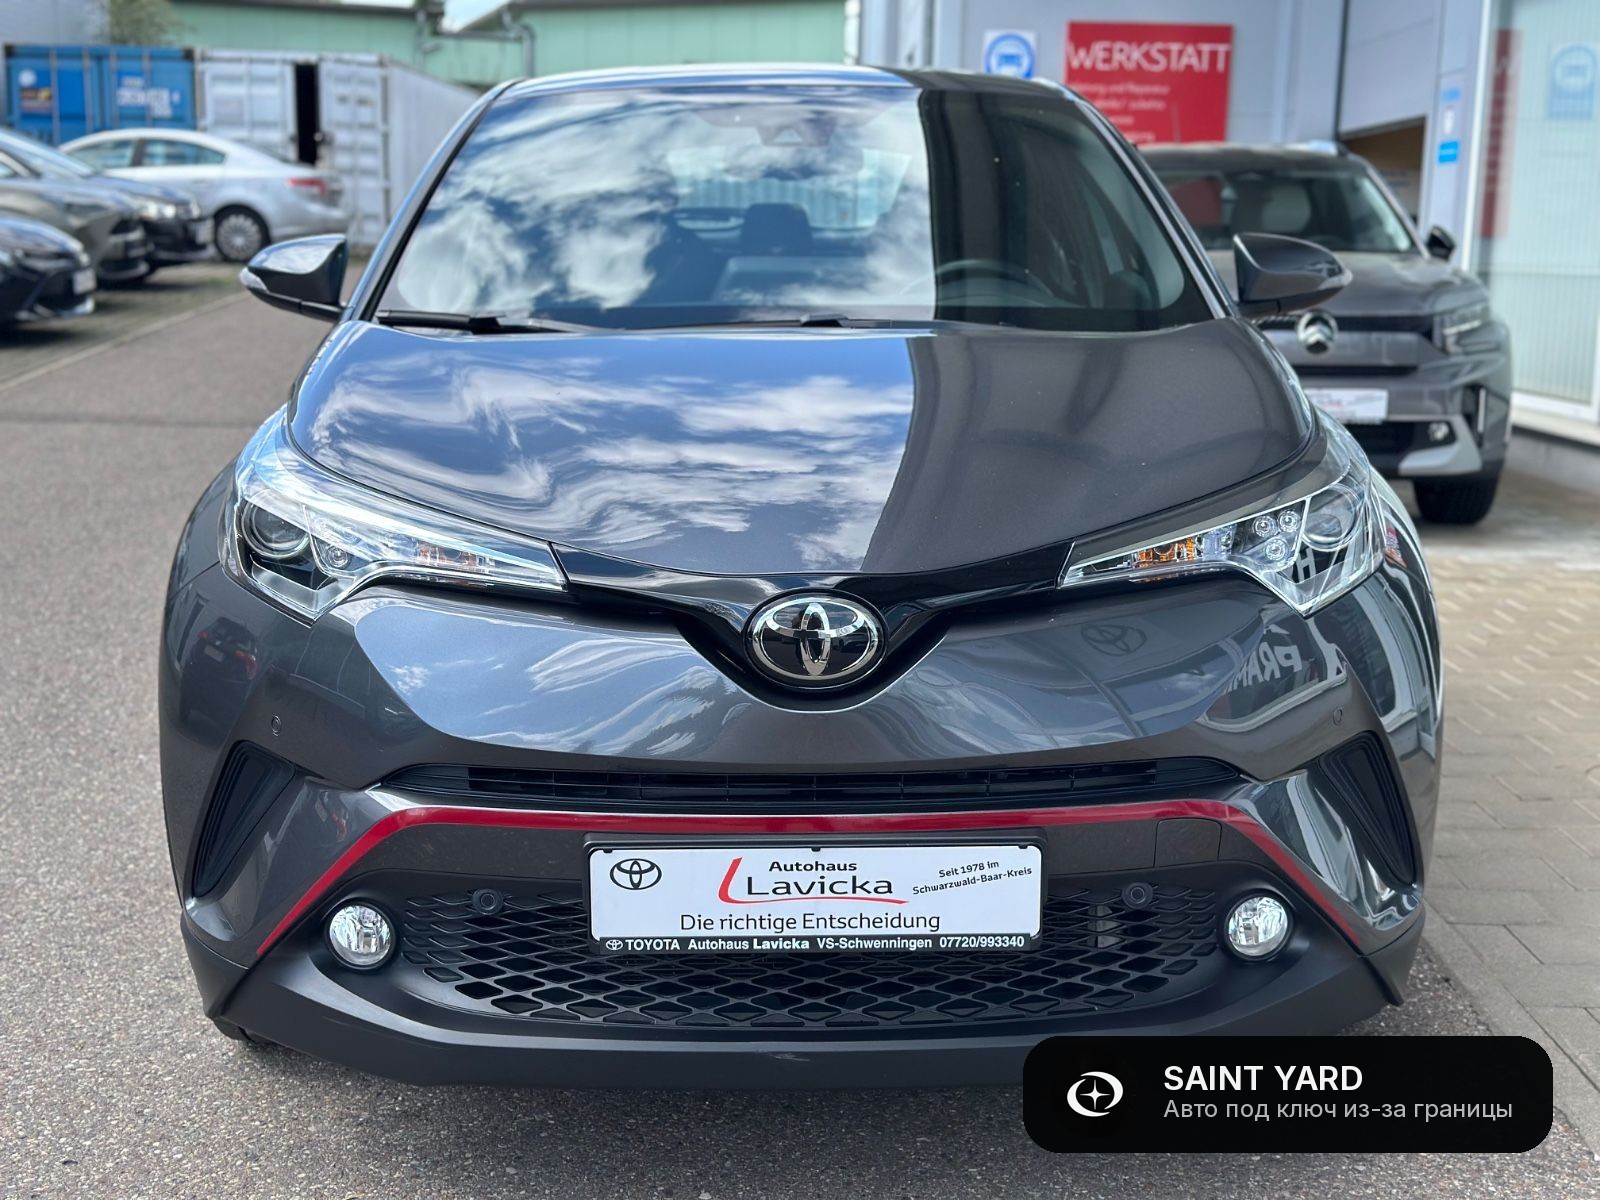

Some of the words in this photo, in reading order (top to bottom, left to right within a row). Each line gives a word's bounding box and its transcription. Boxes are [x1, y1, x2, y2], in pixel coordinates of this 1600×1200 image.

[1067, 40, 1232, 73] WERKSTATT
[768, 860, 858, 872] Autohaus
[938, 868, 959, 878] Seit
[960, 863, 985, 875] 1978
[987, 860, 1000, 869] im
[746, 875, 894, 896] Lavicka
[912, 866, 1033, 895] Schwarzwald-Baar-Kreis
[680, 914, 714, 931] Die
[719, 913, 797, 934] richtige
[802, 912, 940, 933] Entscheidung
[625, 938, 681, 951] TOYOTA
[687, 938, 750, 950] Autohaus
[752, 937, 810, 950] Lavicka
[817, 937, 933, 951] VS-Schwenningen
[939, 936, 1025, 949] 07720/993340
